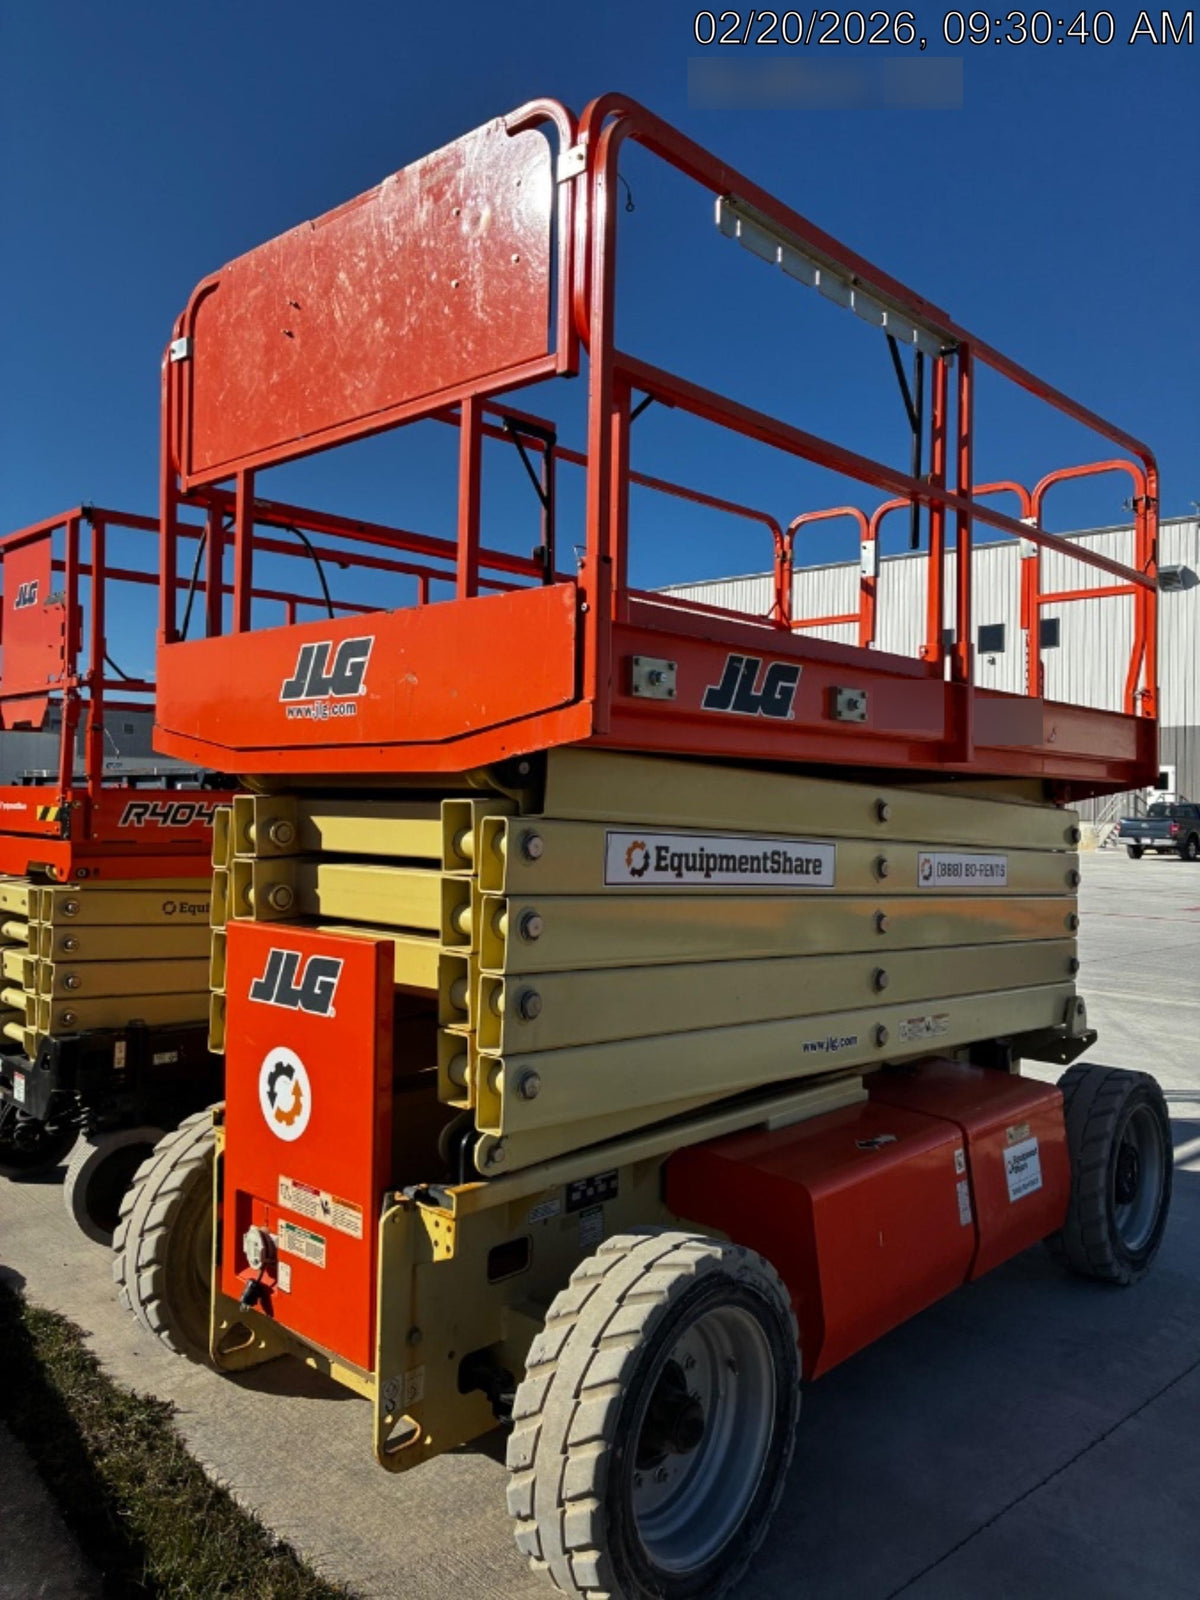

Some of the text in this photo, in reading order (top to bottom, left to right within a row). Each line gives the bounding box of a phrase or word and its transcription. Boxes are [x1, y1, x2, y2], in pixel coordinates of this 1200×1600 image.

[14, 580, 39, 610] JLG
[280, 636, 375, 701] JLG
[701, 653, 802, 720] JLG
[286, 701, 357, 720] www.jlg.com
[118, 801, 234, 827] R404
[654, 845, 823, 878] EquipmentShare
[249, 947, 344, 1018] JLG
[802, 1035, 858, 1053] www.jlg.com
